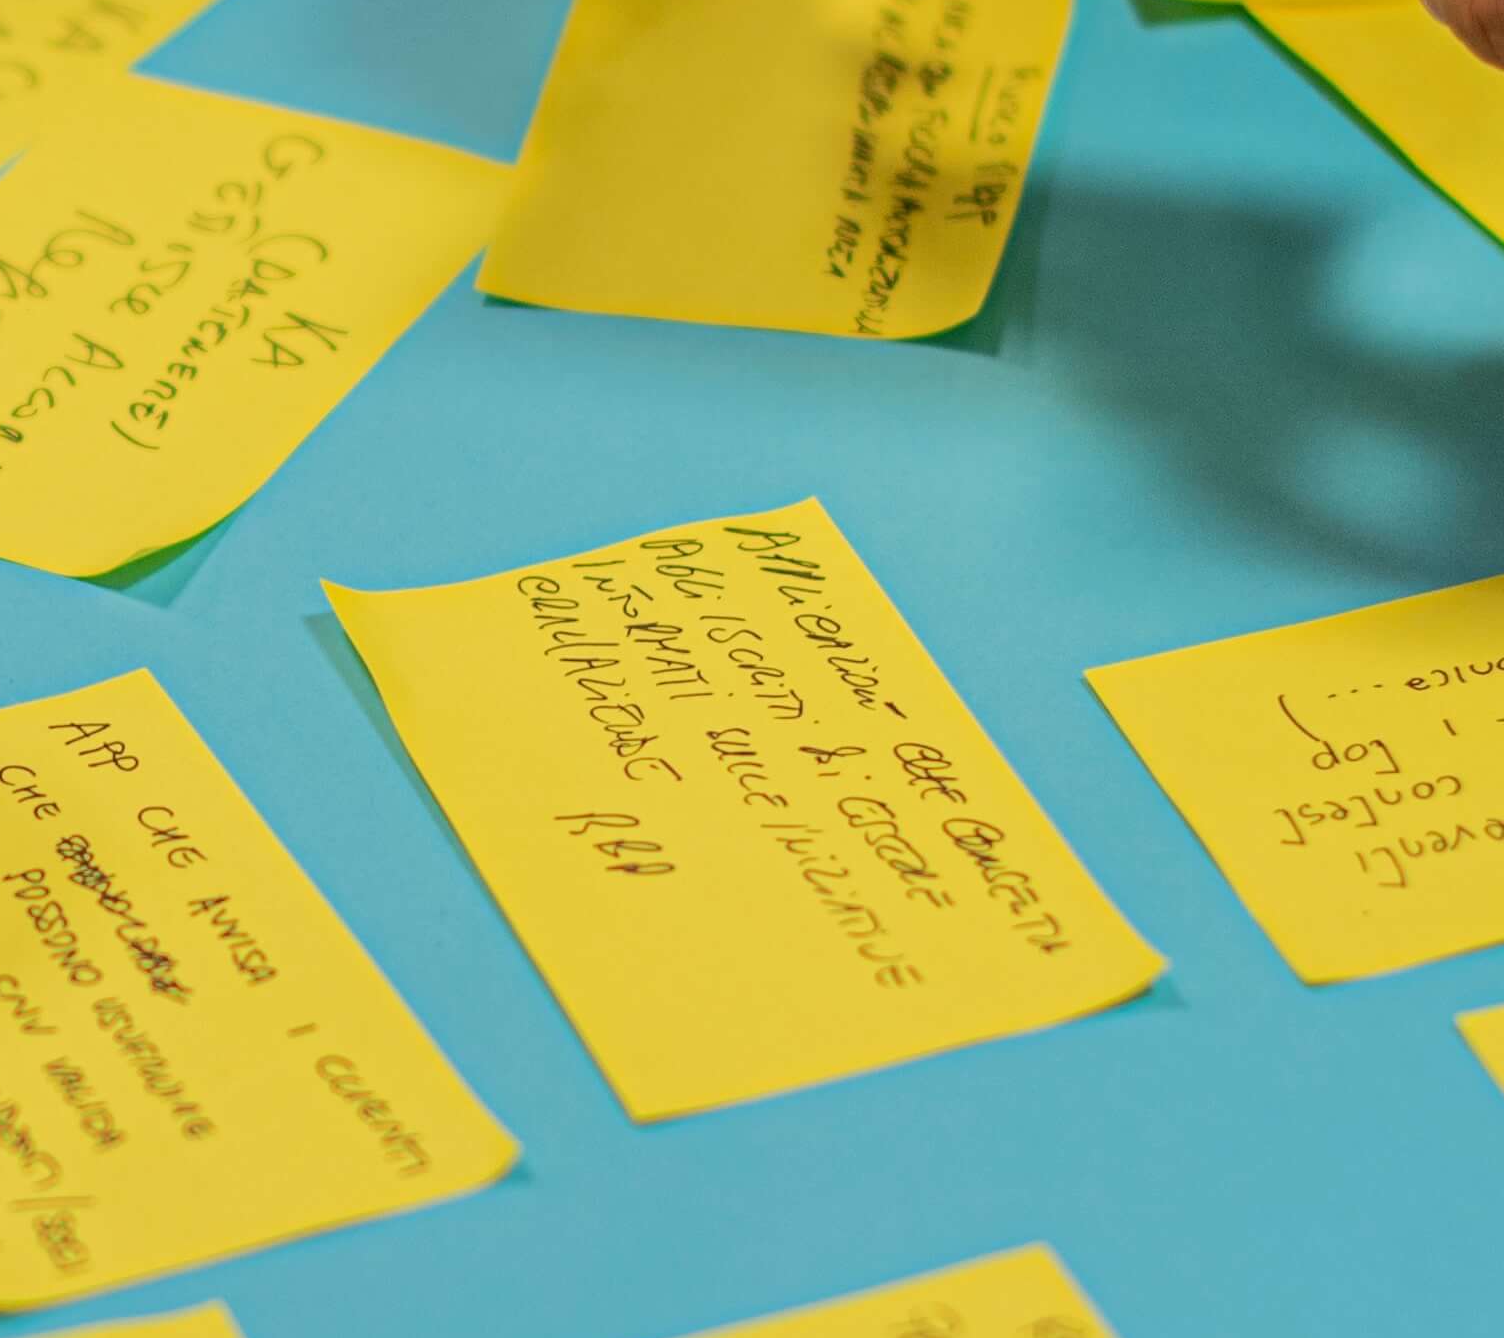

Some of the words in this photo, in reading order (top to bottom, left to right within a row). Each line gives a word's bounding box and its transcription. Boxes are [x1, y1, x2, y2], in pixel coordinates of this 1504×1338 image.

[248, 309, 351, 372] KA
[1308, 735, 1405, 779] top
[45, 719, 143, 776] APP
[133, 802, 210, 872] CHE
[1271, 771, 1467, 850] contest
